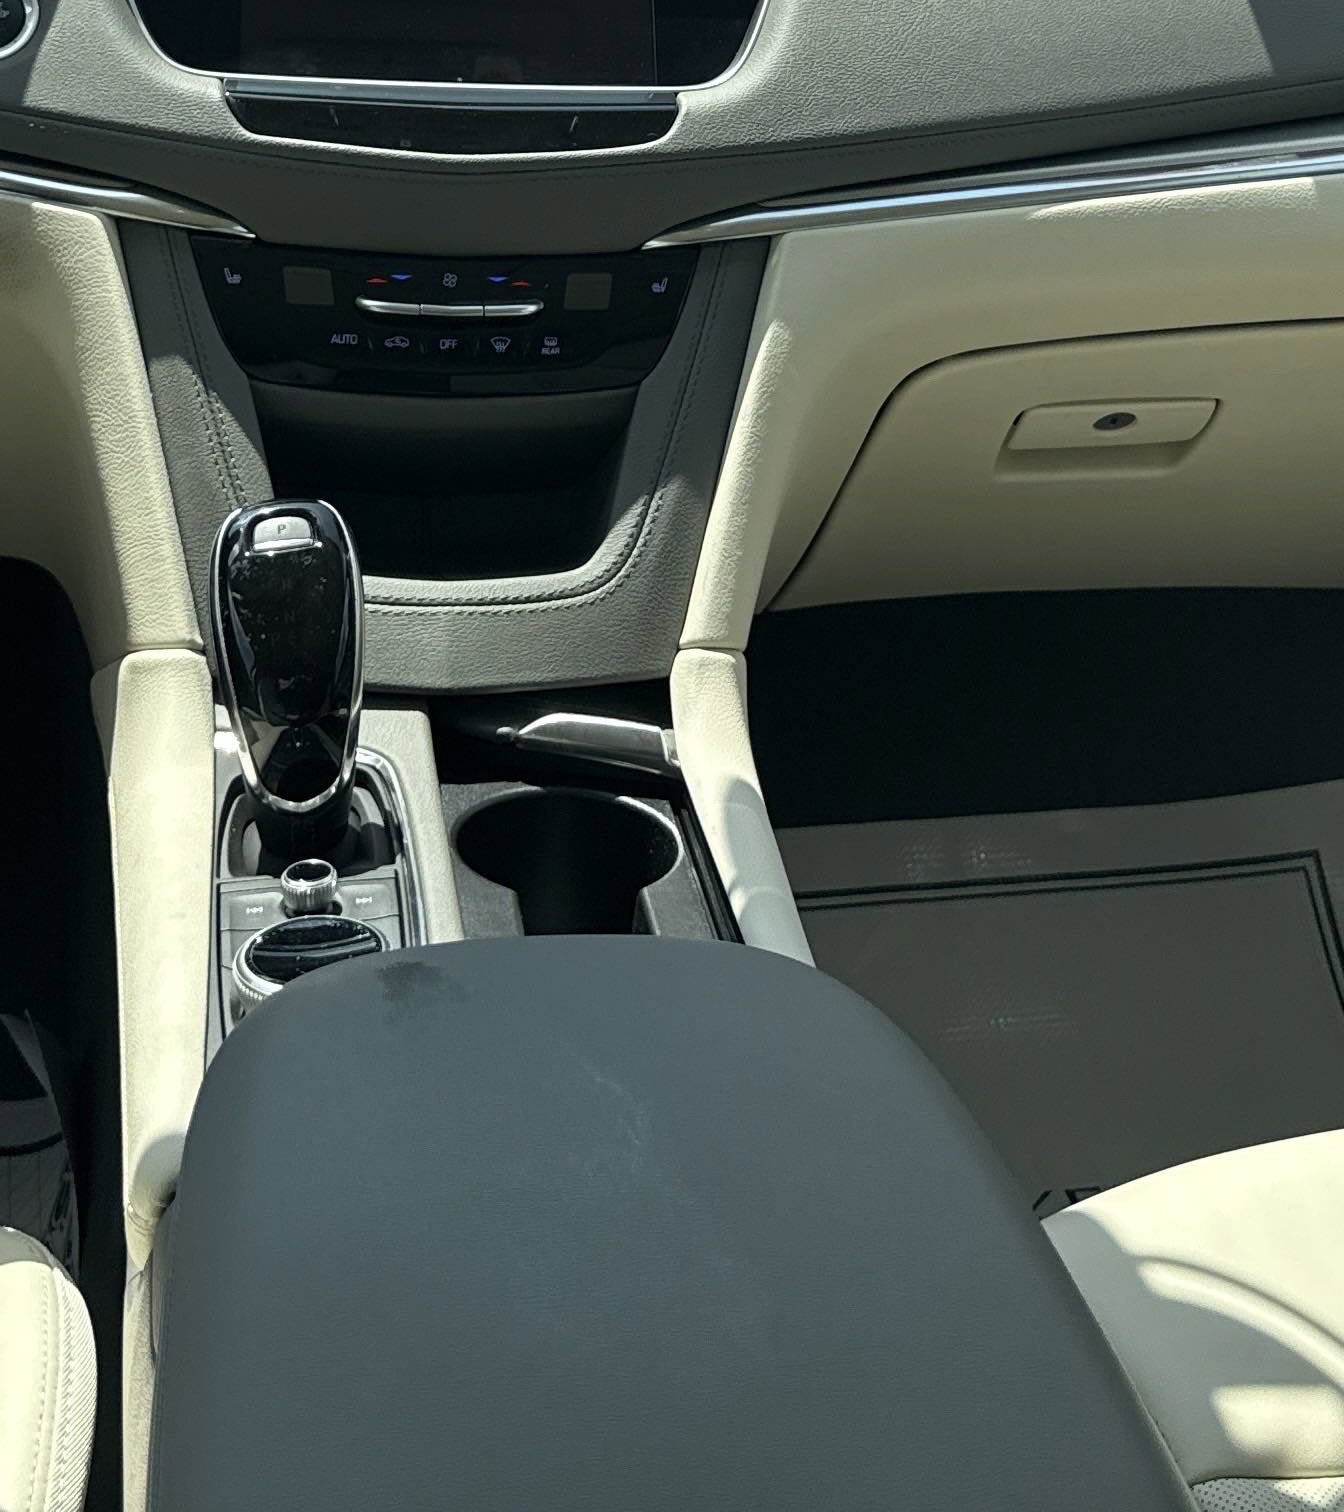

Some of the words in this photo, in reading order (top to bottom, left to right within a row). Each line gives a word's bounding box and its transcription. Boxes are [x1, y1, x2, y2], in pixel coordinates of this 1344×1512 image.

[330, 333, 358, 346] AUTO
[440, 338, 459, 350] OFF
[541, 346, 560, 356] REAR
[277, 524, 287, 535] P
